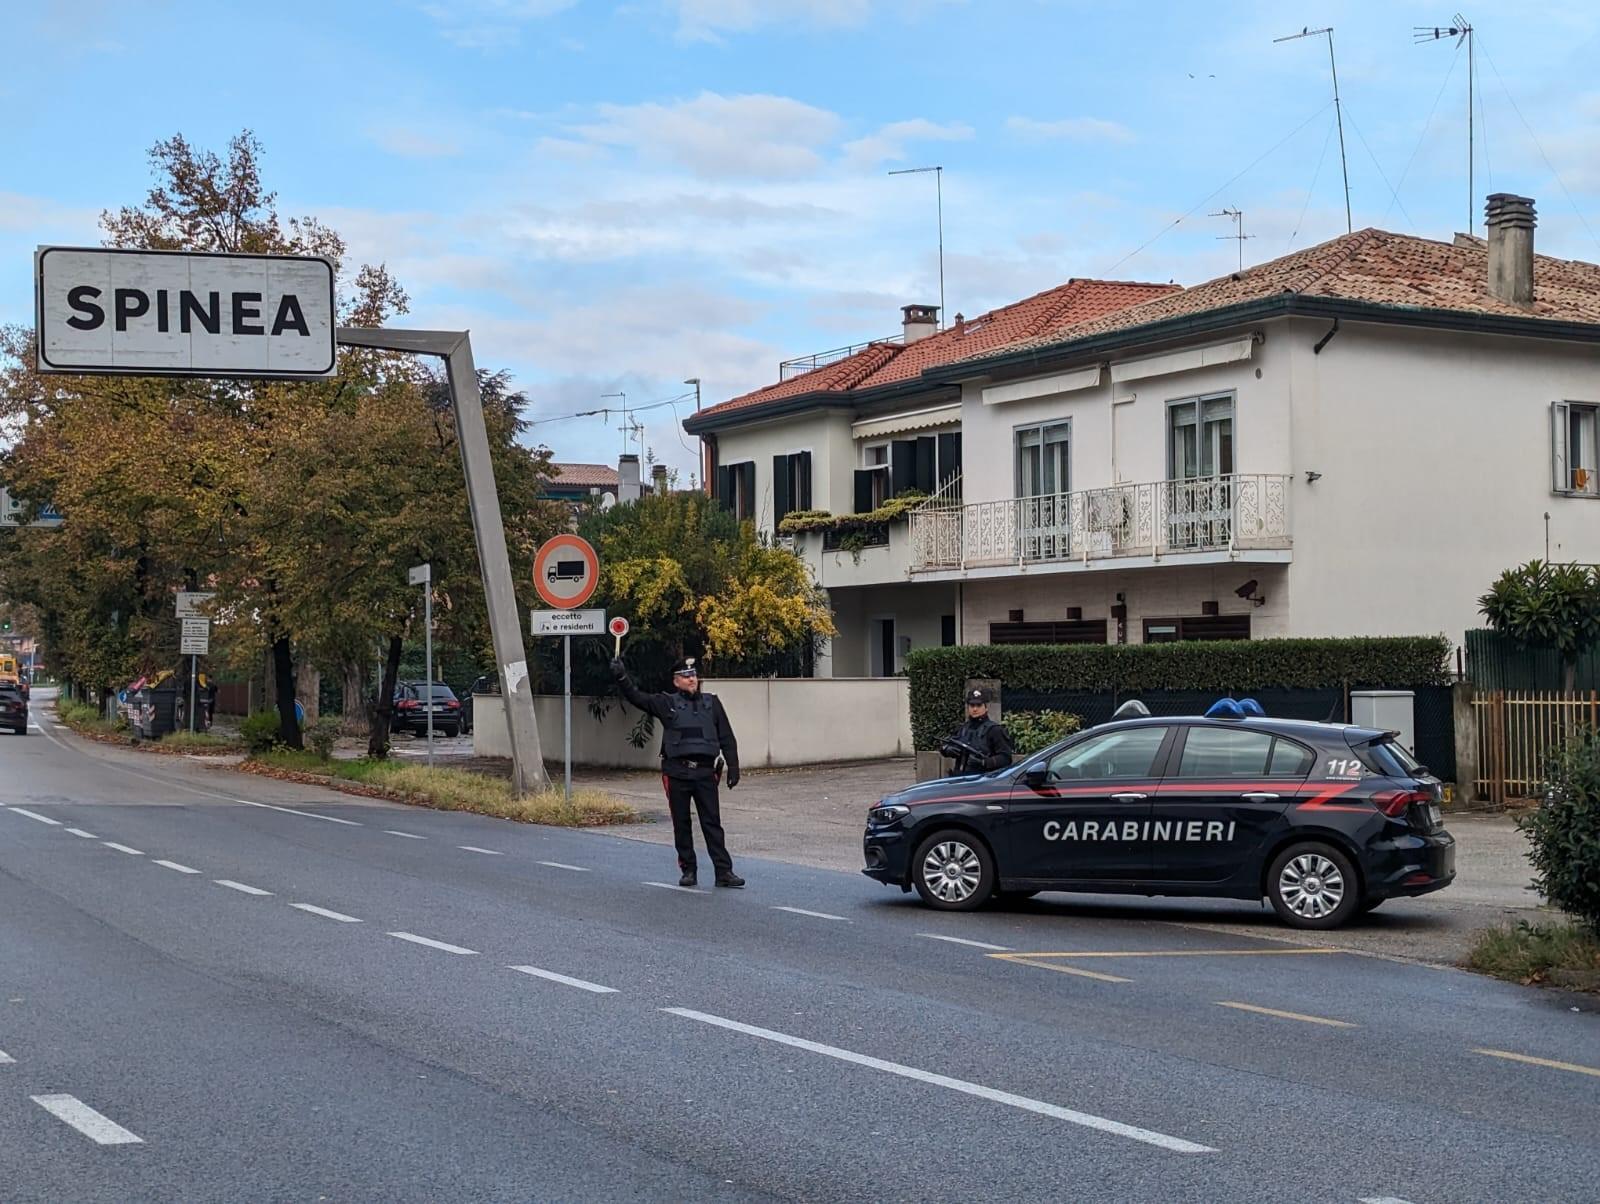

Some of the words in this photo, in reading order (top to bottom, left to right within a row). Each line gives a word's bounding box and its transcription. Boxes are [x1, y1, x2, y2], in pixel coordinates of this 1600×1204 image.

[66, 285, 311, 336] SPINEA
[560, 622, 594, 630] residenti
[1327, 758, 1362, 776] 112
[1043, 820, 1236, 842] CARABINIERI
